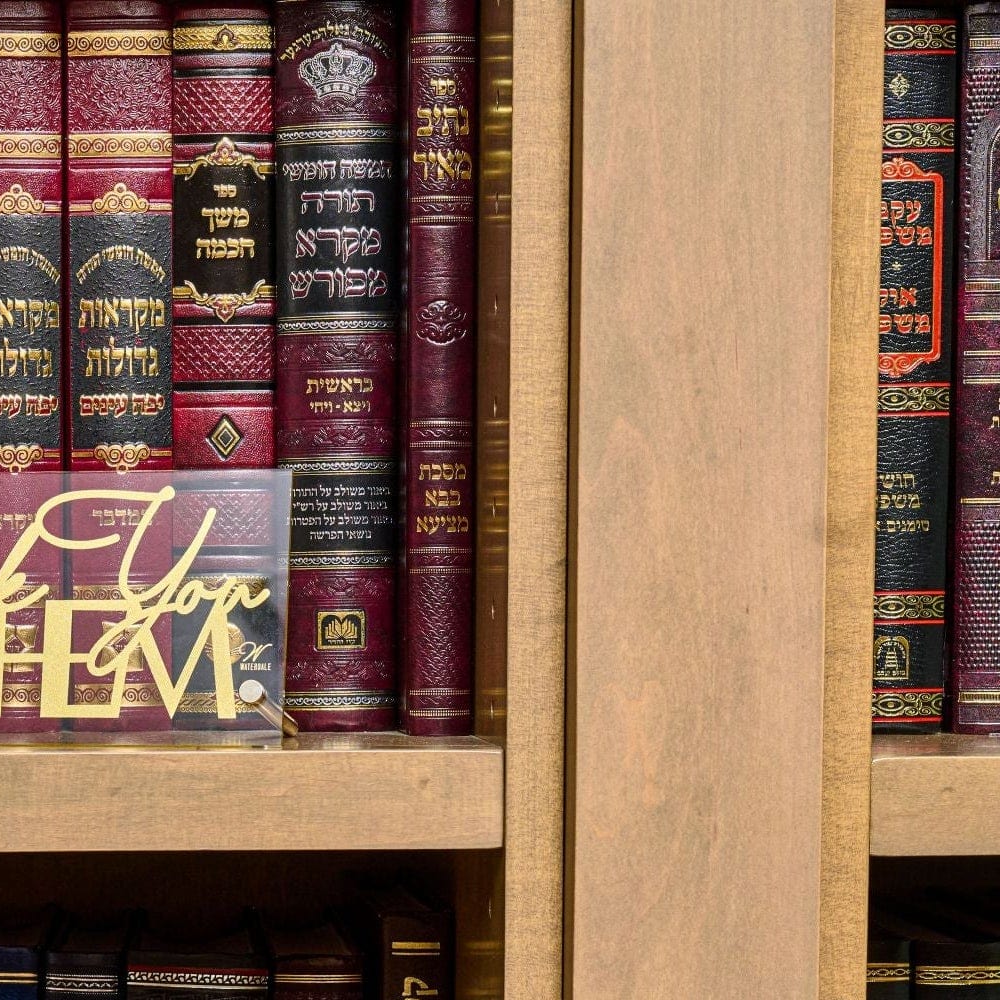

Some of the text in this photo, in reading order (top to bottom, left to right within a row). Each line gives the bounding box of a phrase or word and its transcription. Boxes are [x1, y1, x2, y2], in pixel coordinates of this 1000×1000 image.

[430, 77, 456, 95] ספר
[417, 104, 469, 137] נתיב
[283, 160, 337, 181] חומשי
[413, 149, 472, 181] מאיר
[213, 184, 237, 198] ספר
[301, 188, 375, 215] תורה
[201, 206, 250, 233] משך
[196, 237, 255, 259] חכמה
[295, 226, 382, 264] מקרא
[289, 267, 389, 300] מפורש
[78, 297, 165, 335] מקראות
[85, 336, 159, 377] גדולות
[306, 377, 374, 394] בראשית
[25, 394, 59, 416] יפה
[80, 394, 166, 419] יפה עינים
[419, 463, 467, 481] מסכת
[319, 484, 365, 497] משולב על
[425, 486, 461, 507] בבא
[315, 499, 362, 511] משולב על
[323, 513, 336, 526] על
[416, 515, 469, 535] מציעא
